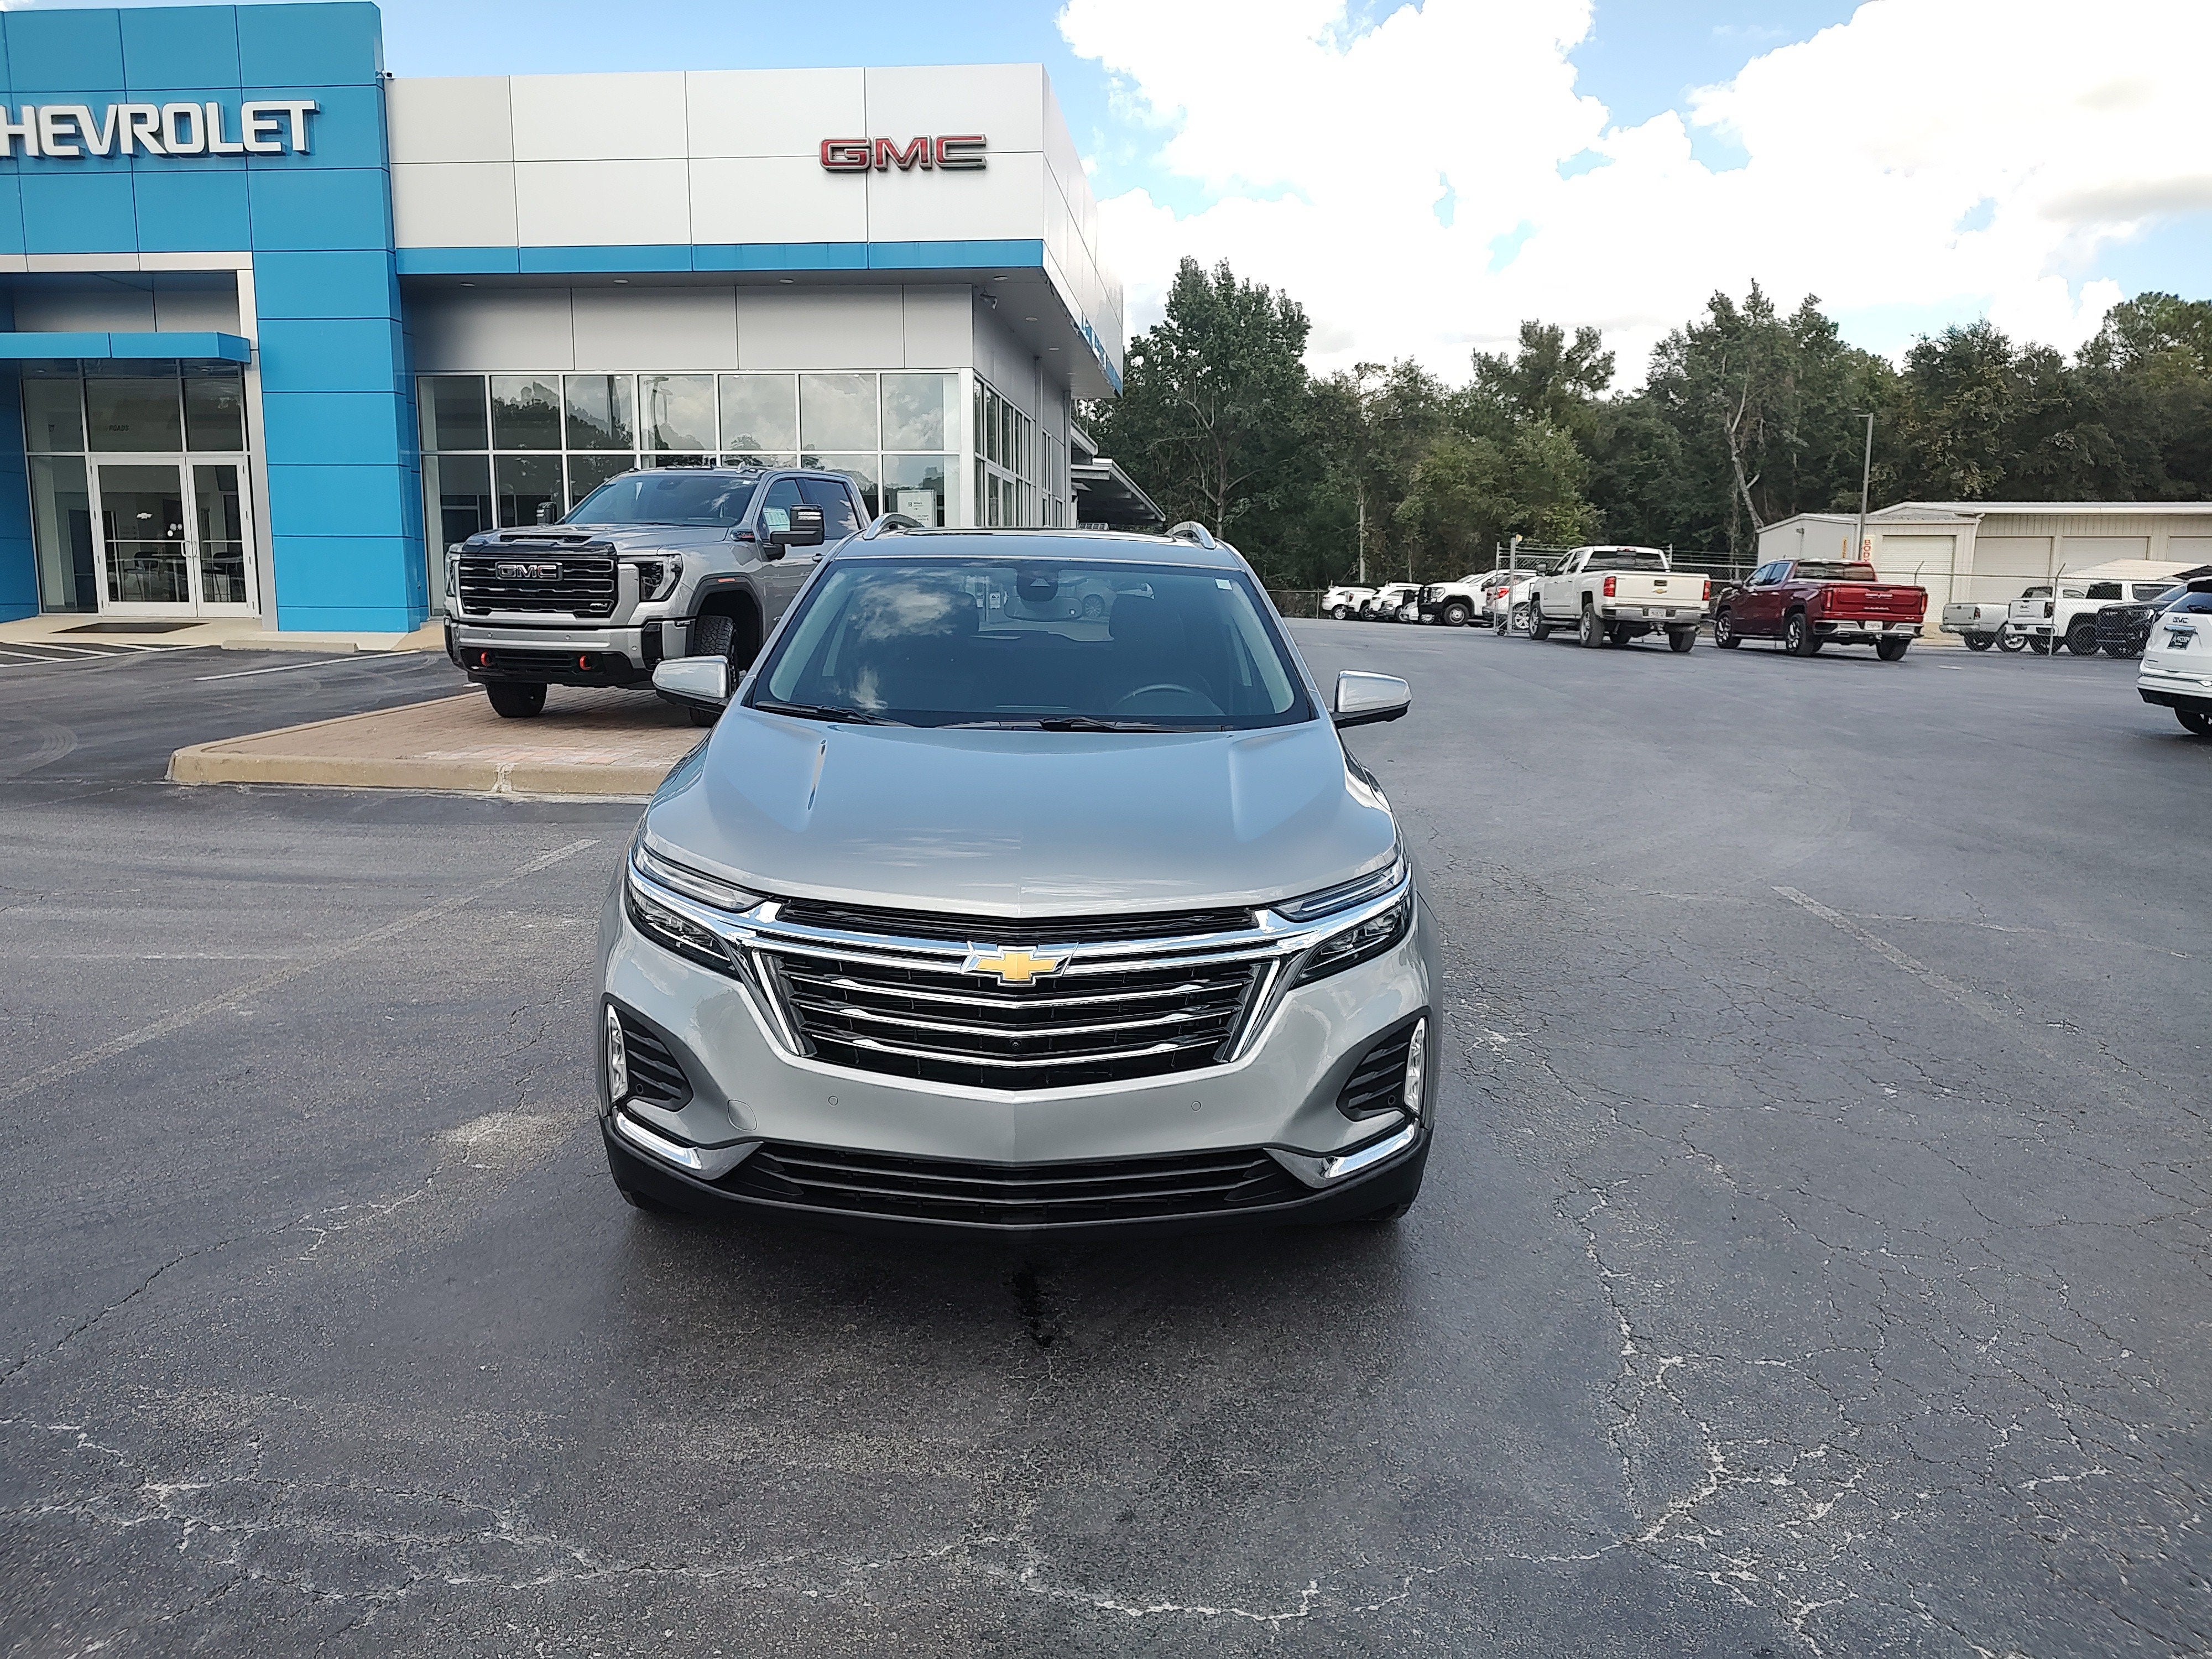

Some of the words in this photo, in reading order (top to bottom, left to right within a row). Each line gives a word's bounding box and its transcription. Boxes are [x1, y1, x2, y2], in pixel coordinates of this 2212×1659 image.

[0, 100, 316, 157] HEVROLET
[819, 134, 987, 173] GMC
[498, 565, 557, 578] GMC
